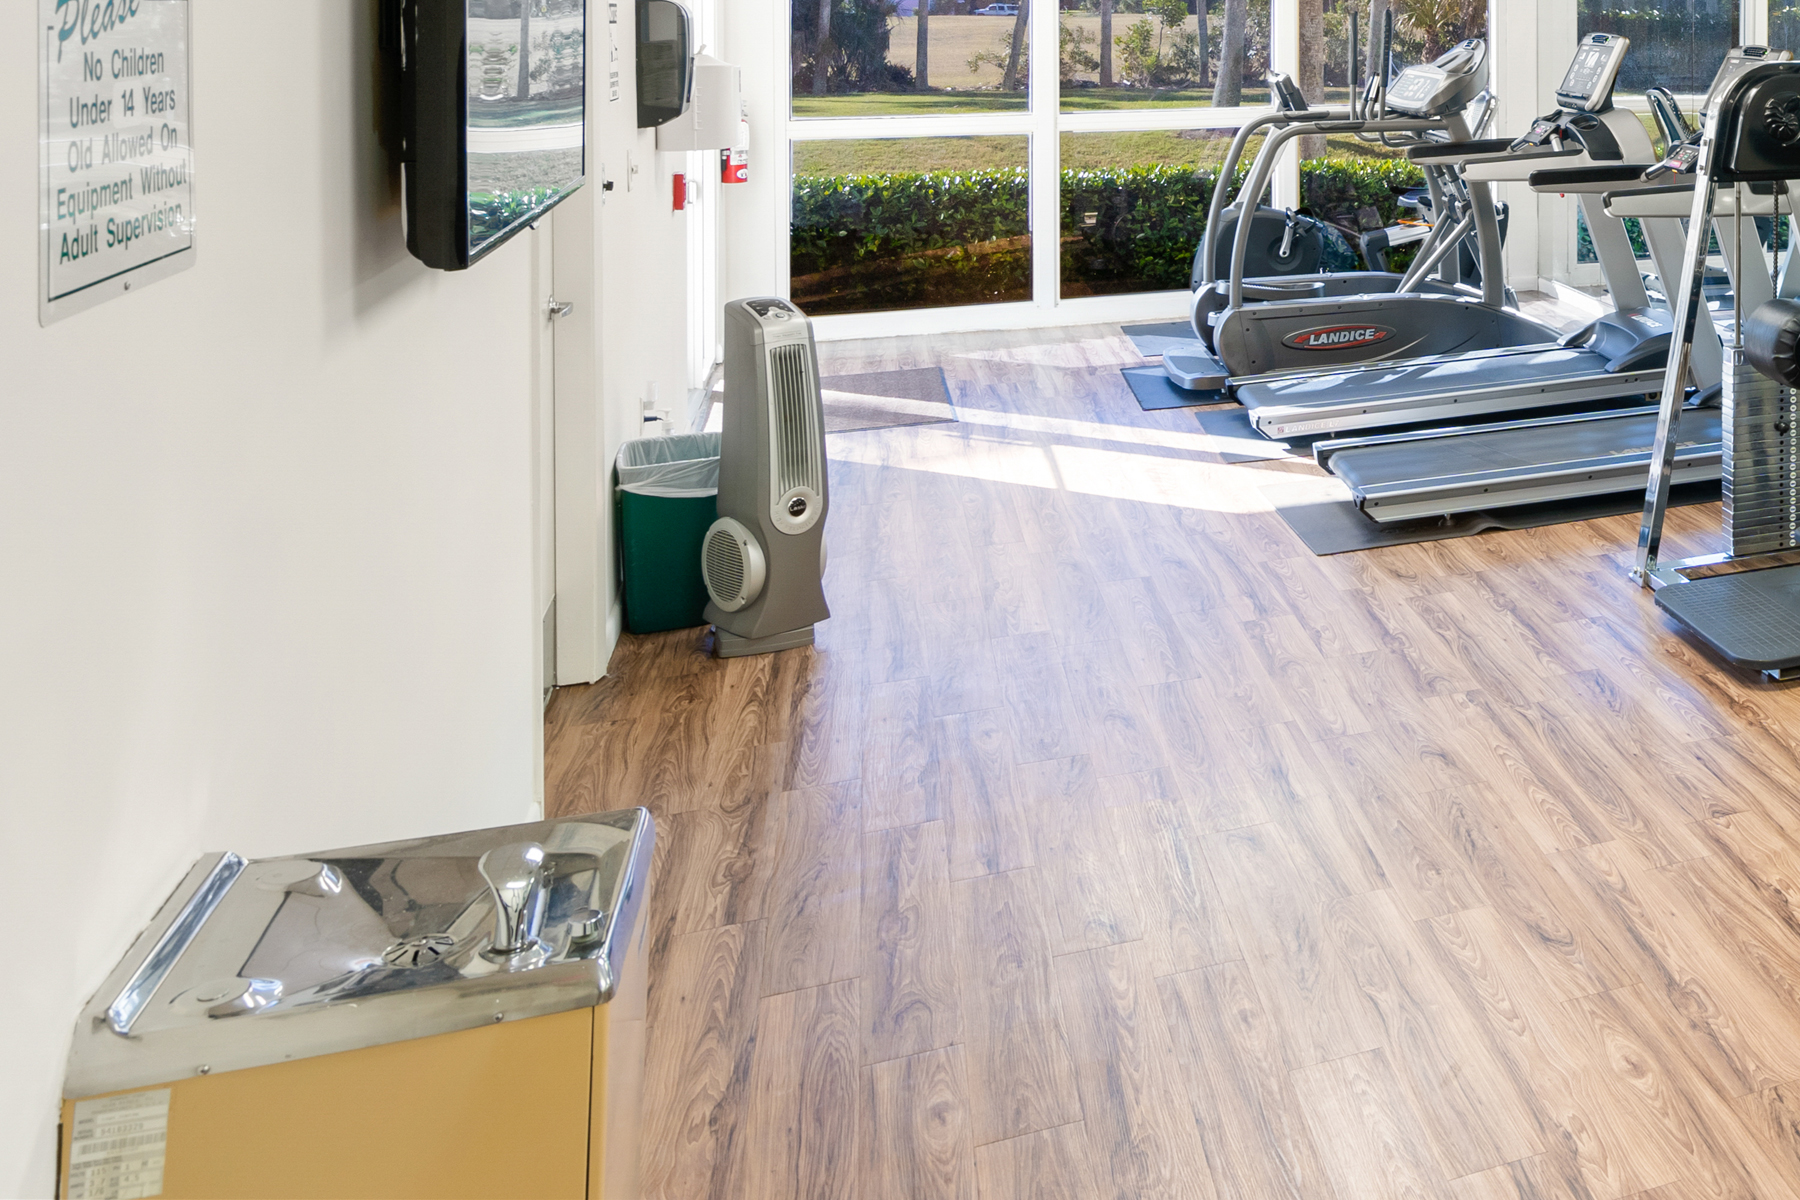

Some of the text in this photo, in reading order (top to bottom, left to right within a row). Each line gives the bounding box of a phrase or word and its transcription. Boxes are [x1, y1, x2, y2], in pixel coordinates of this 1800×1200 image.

[84, 47, 164, 82] No Children
[70, 86, 176, 129] Under 14 Years
[67, 122, 178, 173] Old Allowed On
[57, 158, 187, 226] Equipment Without
[59, 224, 99, 265] Adult
[1309, 329, 1375, 345] LANDICE
